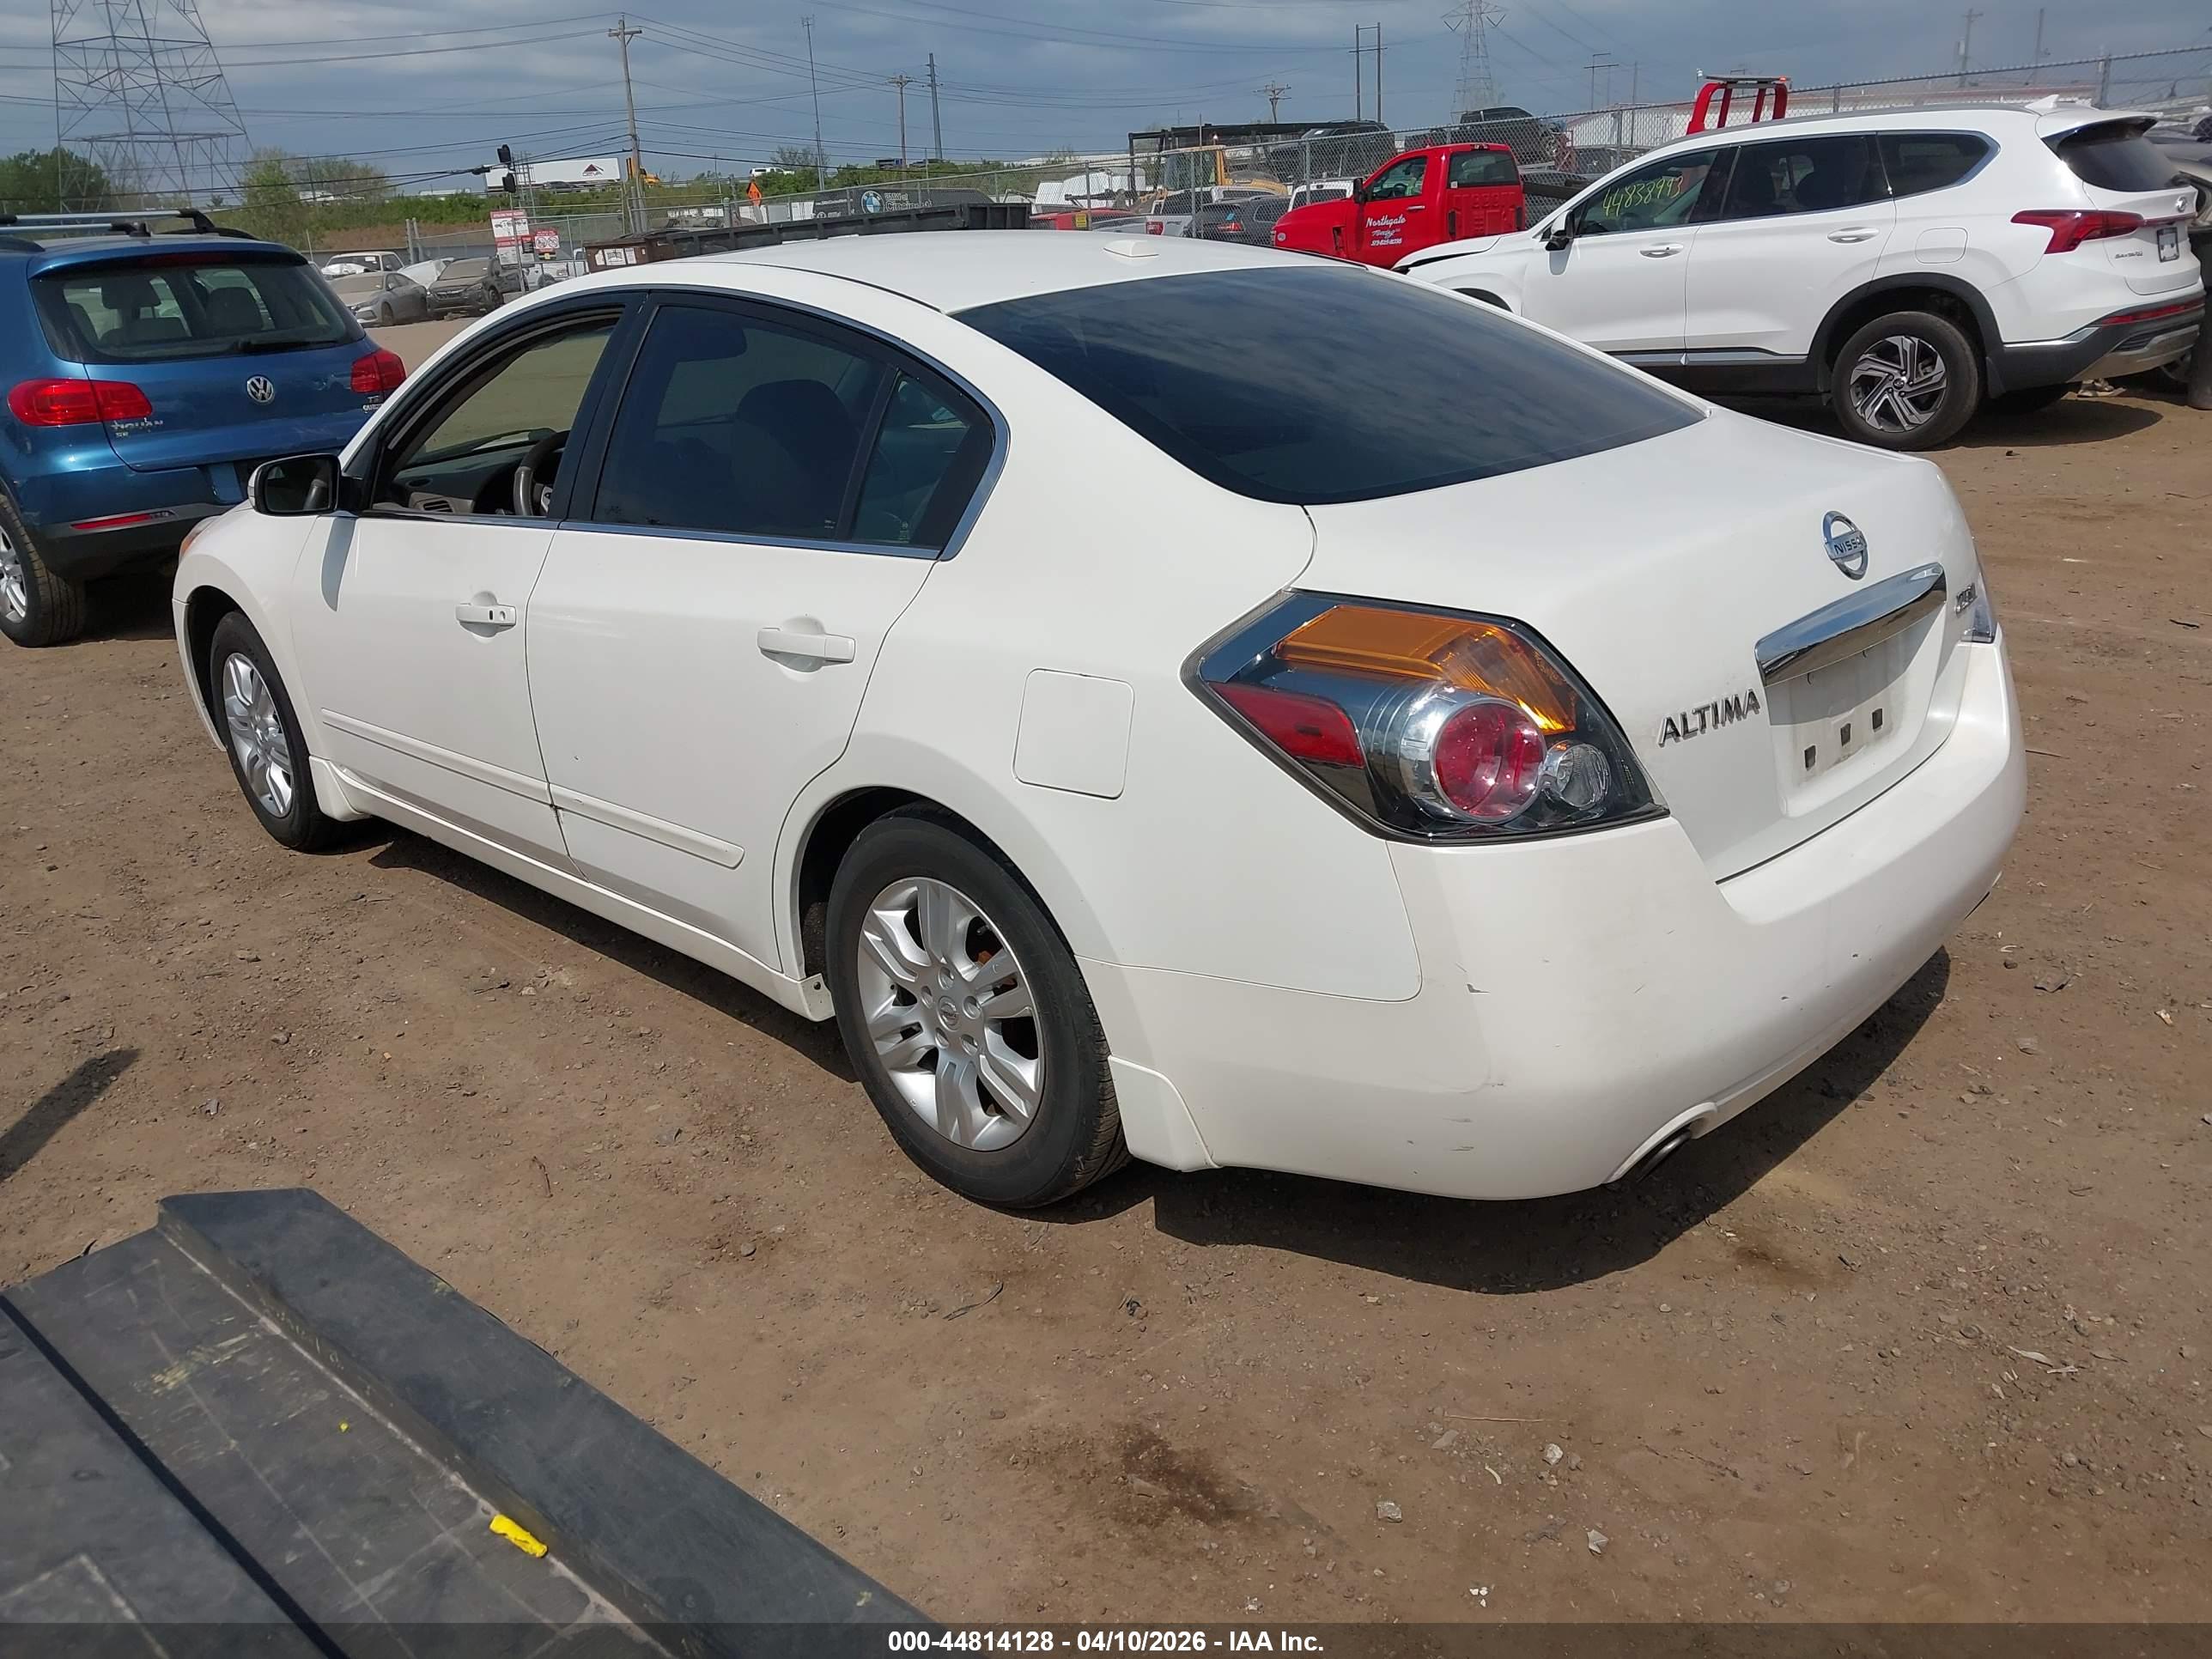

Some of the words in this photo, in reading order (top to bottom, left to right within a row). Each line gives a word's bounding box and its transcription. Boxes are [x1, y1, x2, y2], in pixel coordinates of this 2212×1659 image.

[1602, 175, 1683, 216] 44838993
[1365, 214, 1407, 228] Northgate
[1657, 688, 1760, 748] ALTIMA
